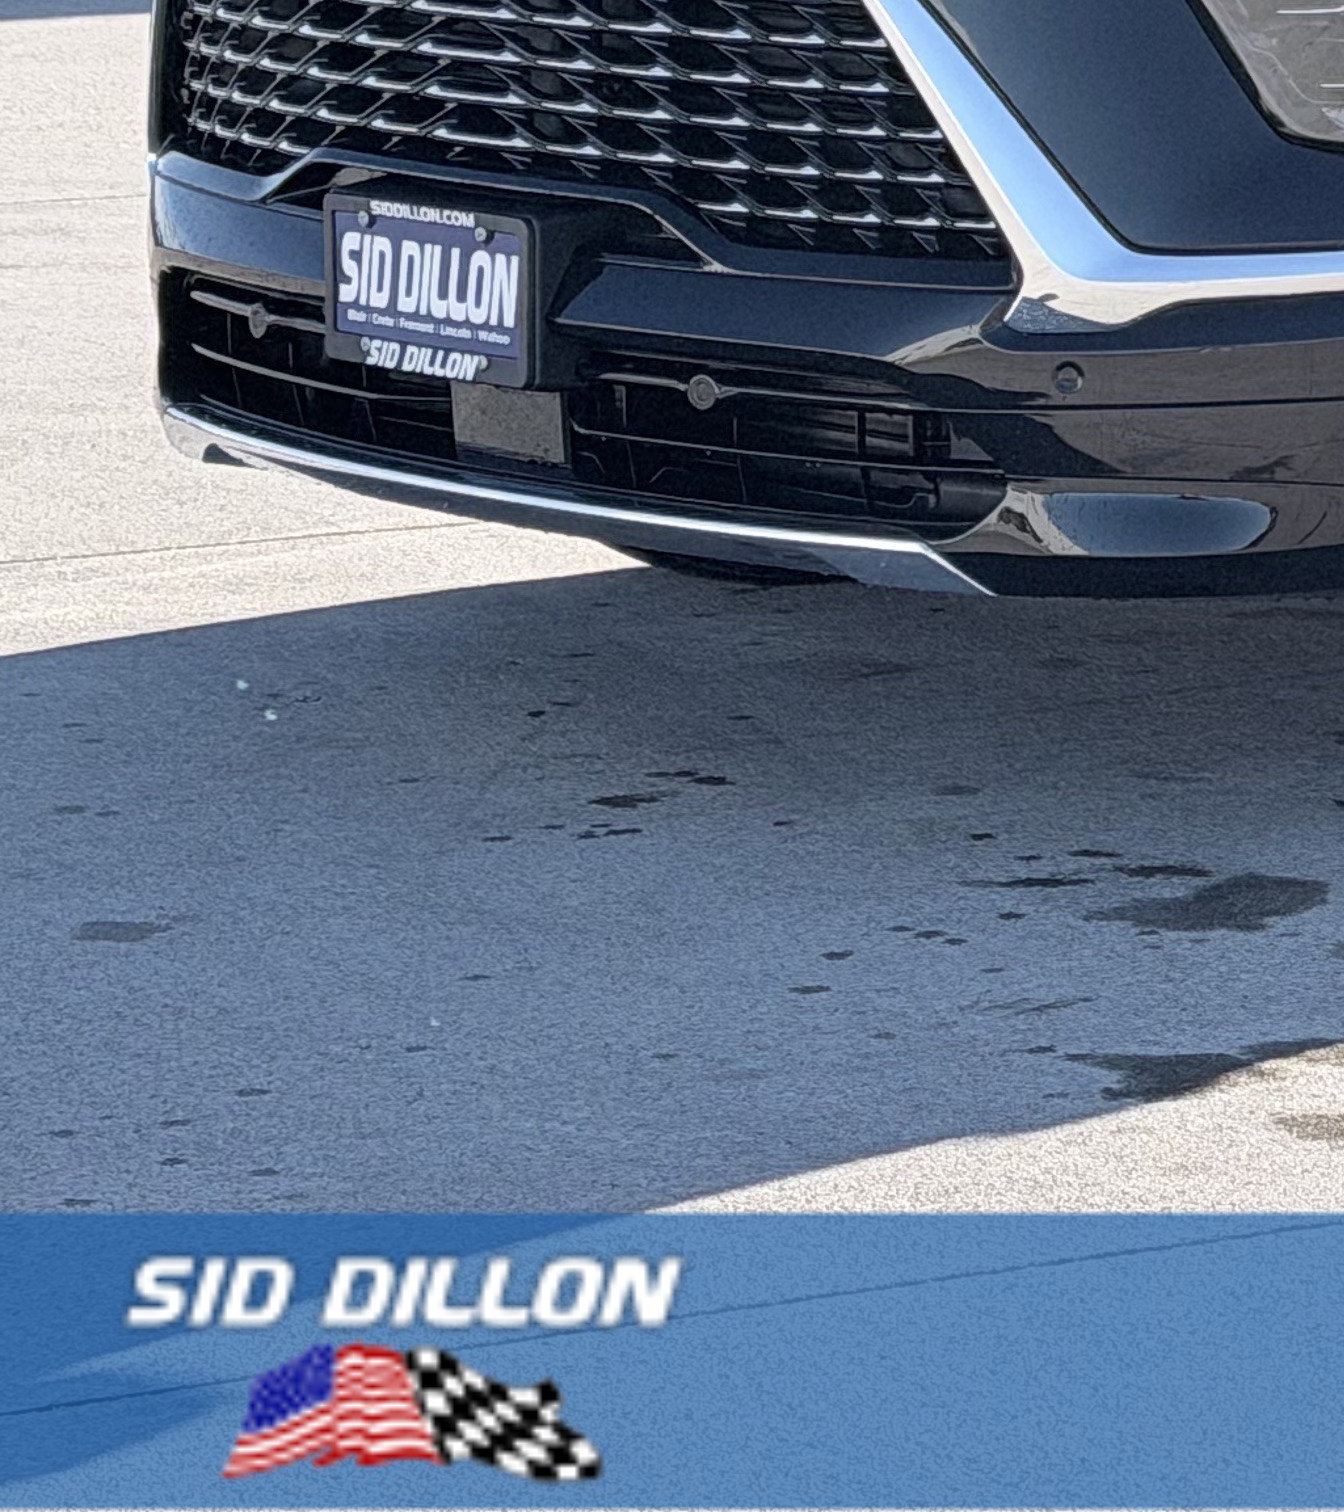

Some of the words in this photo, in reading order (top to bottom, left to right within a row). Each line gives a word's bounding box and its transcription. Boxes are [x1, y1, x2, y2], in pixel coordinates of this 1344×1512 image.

[369, 200, 475, 228] SIDDILLON.COM
[338, 231, 393, 309] SID
[396, 239, 520, 329] DILLON
[399, 317, 435, 334] Fremont
[364, 339, 400, 369] SID
[401, 344, 481, 381] DILLON
